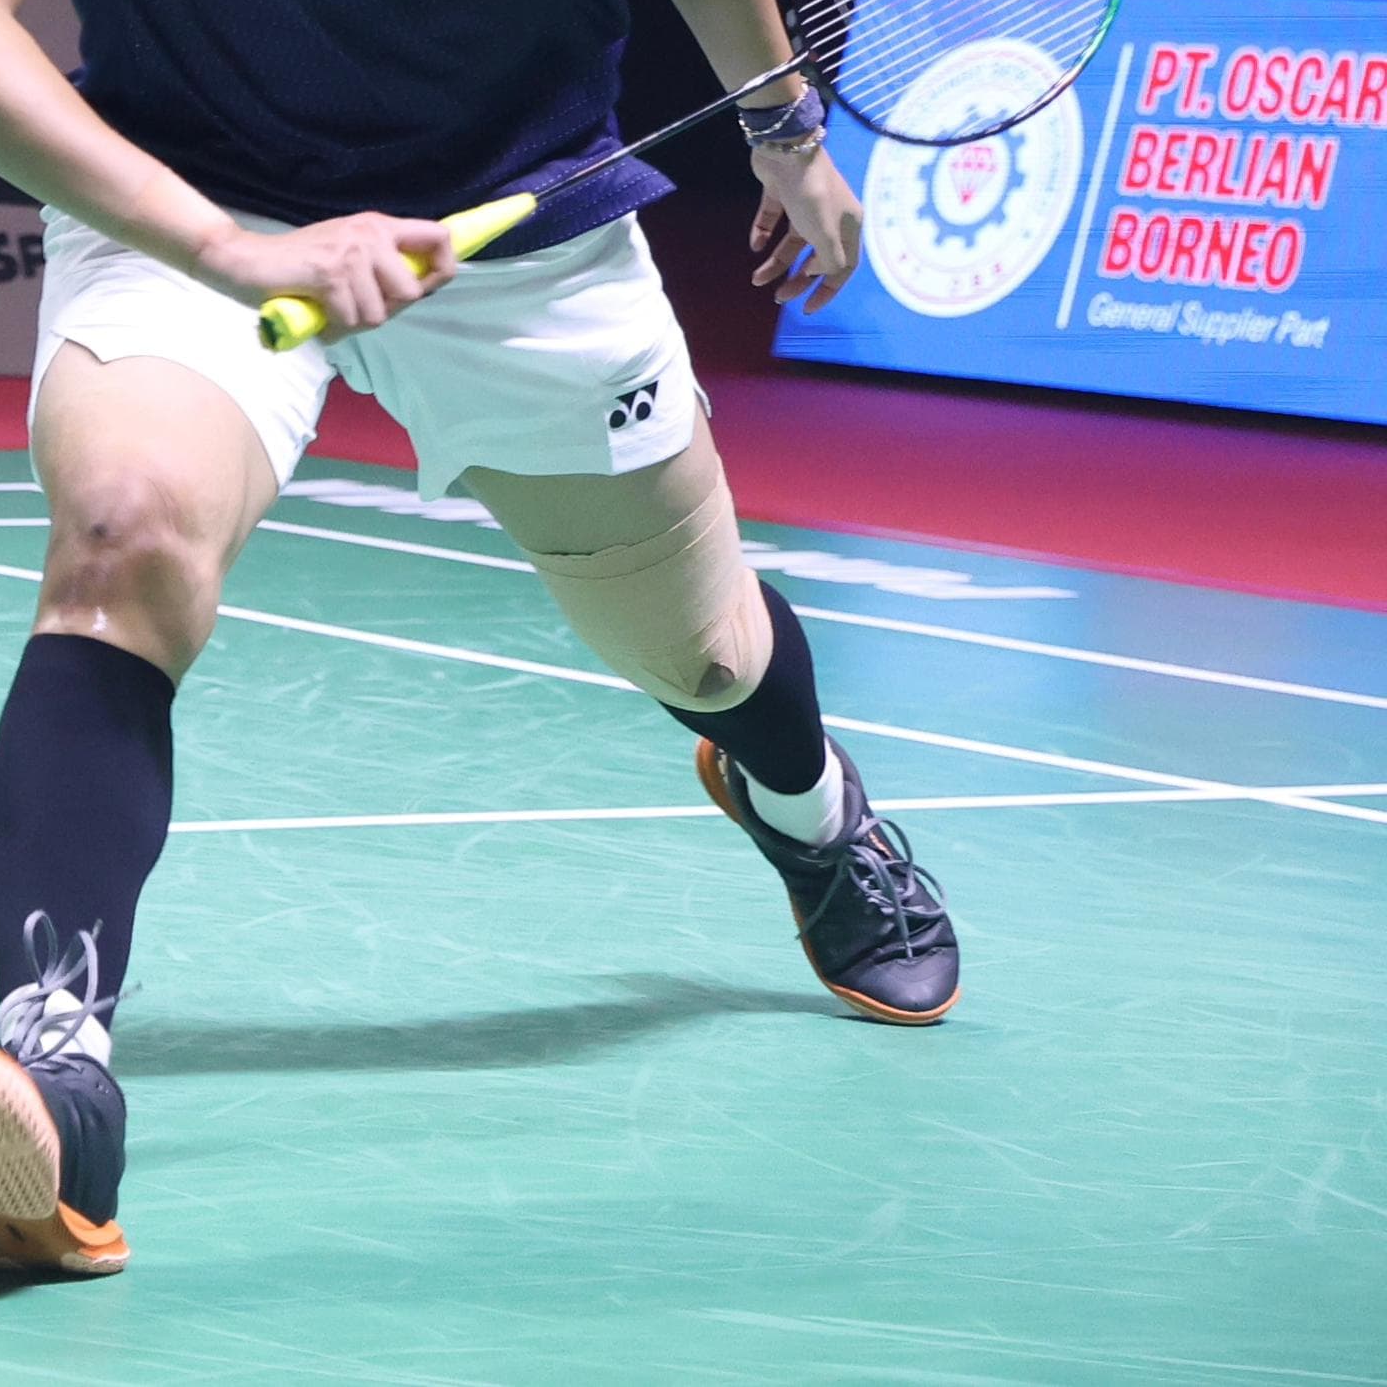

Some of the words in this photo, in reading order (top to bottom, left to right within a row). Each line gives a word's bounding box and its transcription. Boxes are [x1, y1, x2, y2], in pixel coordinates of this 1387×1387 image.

[1139, 45, 1215, 115] PT.
[1222, 49, 1387, 125] OSCAR
[1122, 128, 1337, 206] BERLIAN
[1101, 209, 1302, 290] BORNEO
[1088, 293, 1181, 332] General
[1178, 301, 1277, 346] Supplier
